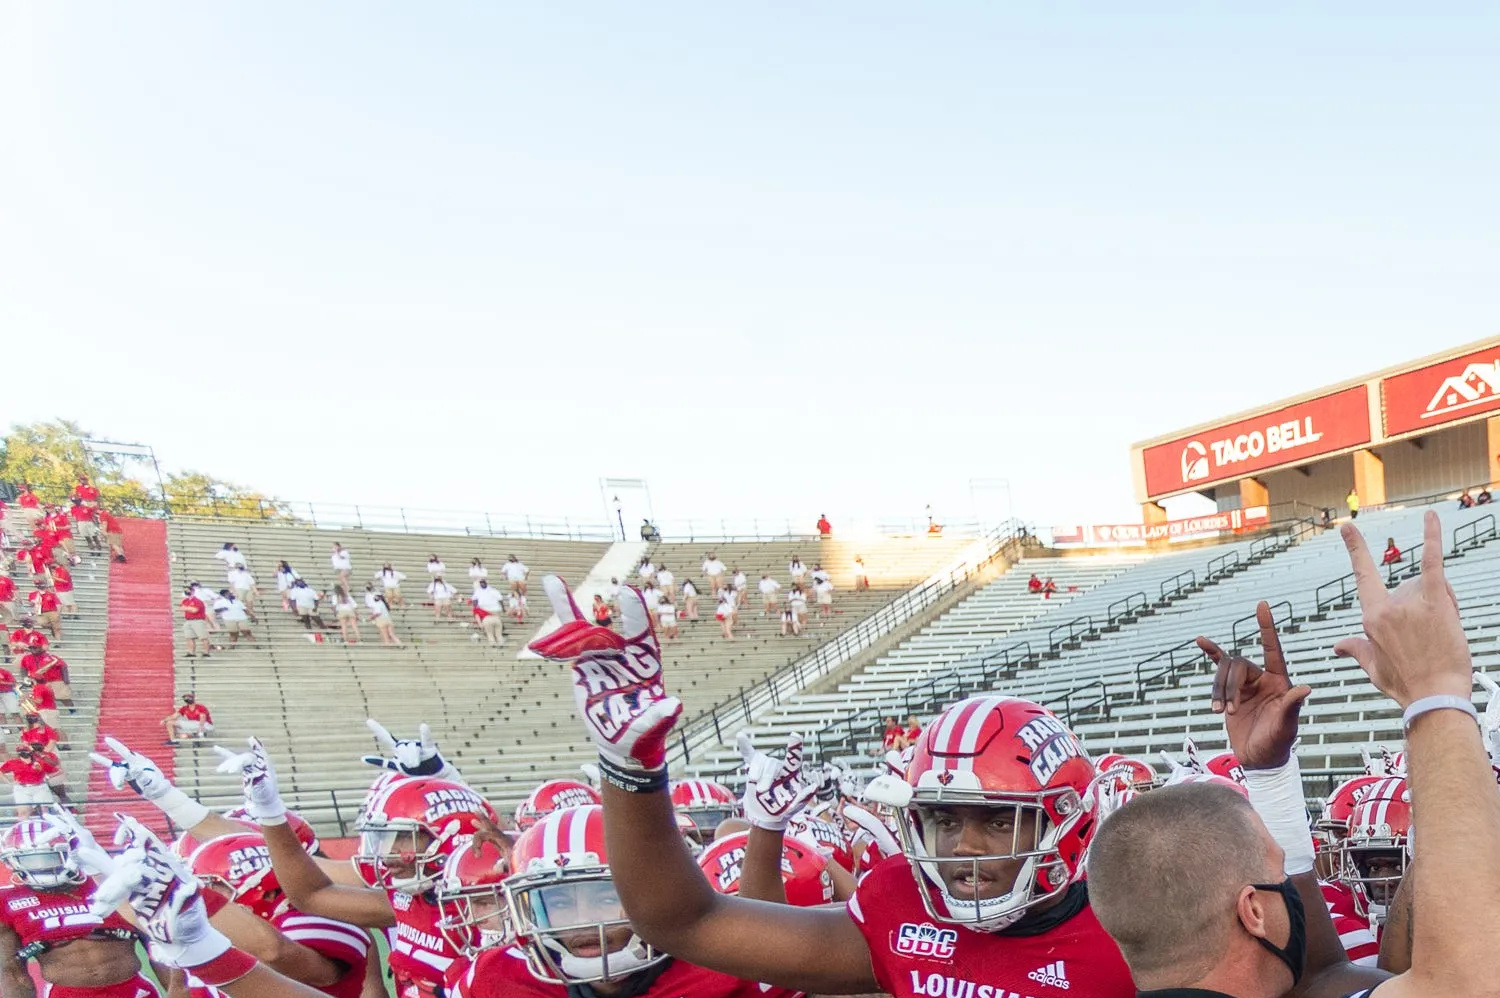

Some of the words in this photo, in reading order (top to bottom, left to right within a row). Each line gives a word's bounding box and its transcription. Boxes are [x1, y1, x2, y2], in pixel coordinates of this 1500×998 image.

[1210, 430, 1265, 467] TACO
[1266, 416, 1322, 454] BELL
[1142, 523, 1170, 539] LADY
[1170, 523, 1183, 535] OF
[1184, 515, 1229, 533] LOURDES
[896, 922, 958, 959] SBC
[1027, 969, 1071, 991] adidas
